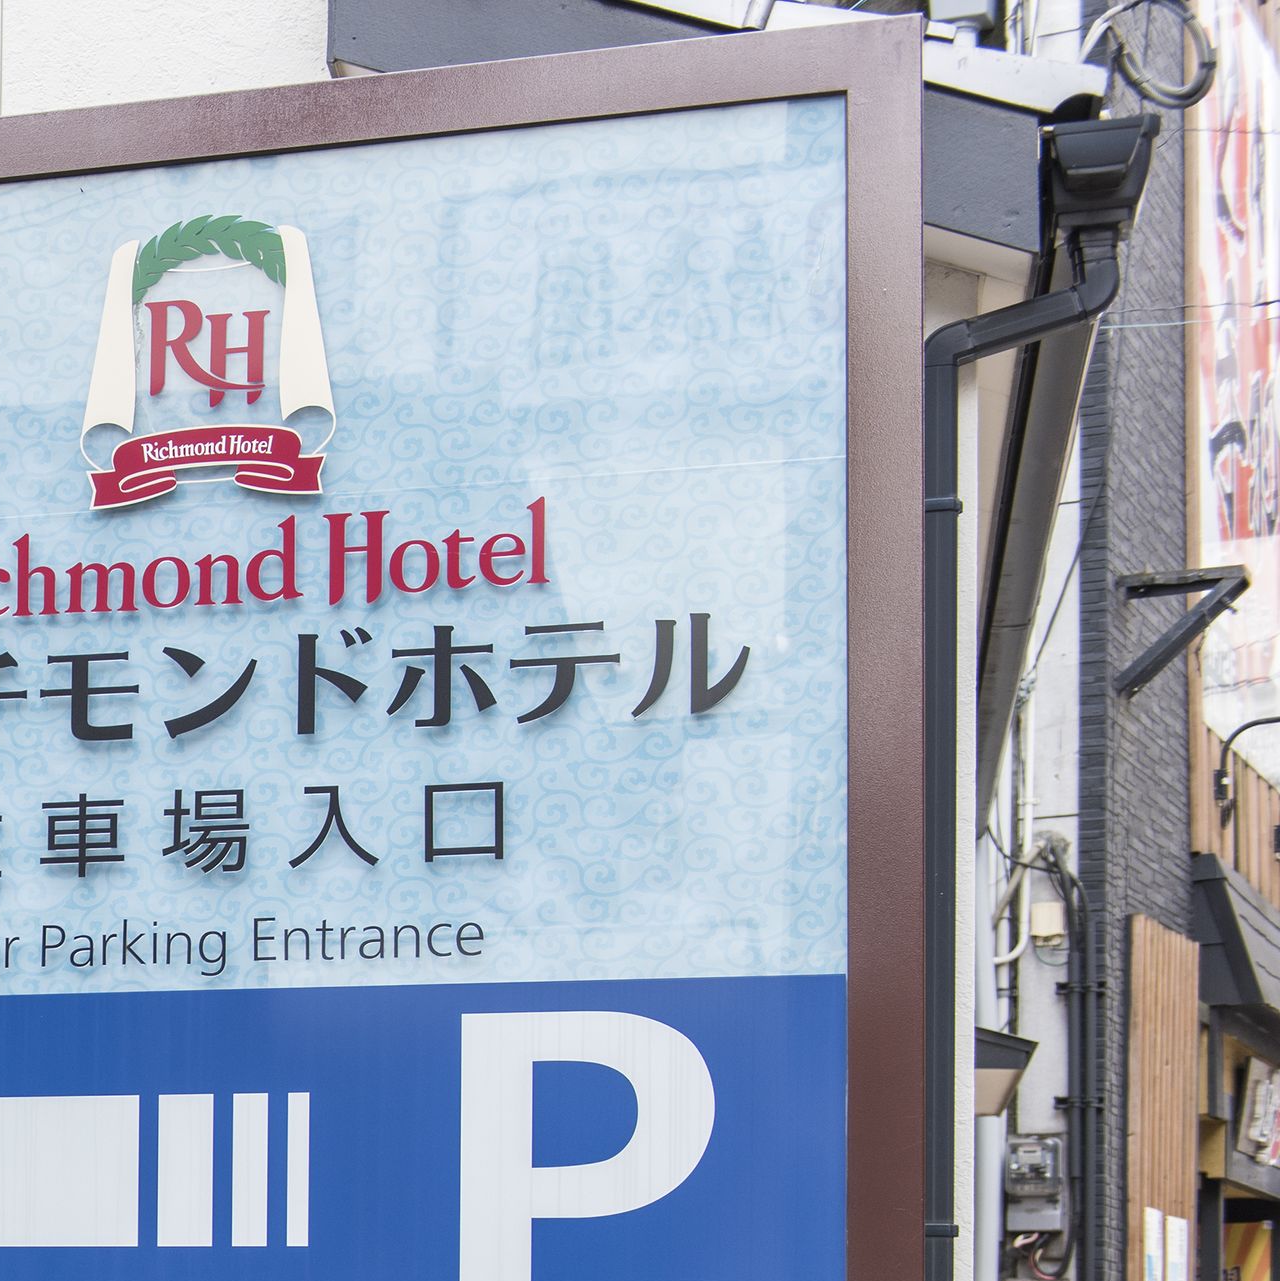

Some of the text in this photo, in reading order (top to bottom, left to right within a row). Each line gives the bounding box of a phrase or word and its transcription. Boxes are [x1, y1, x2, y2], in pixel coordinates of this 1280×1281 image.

[141, 435, 273, 463] Richmond Hotel
[323, 497, 550, 605] Hotel
[41, 919, 228, 978] Parking
[251, 913, 485, 962] Entrance
